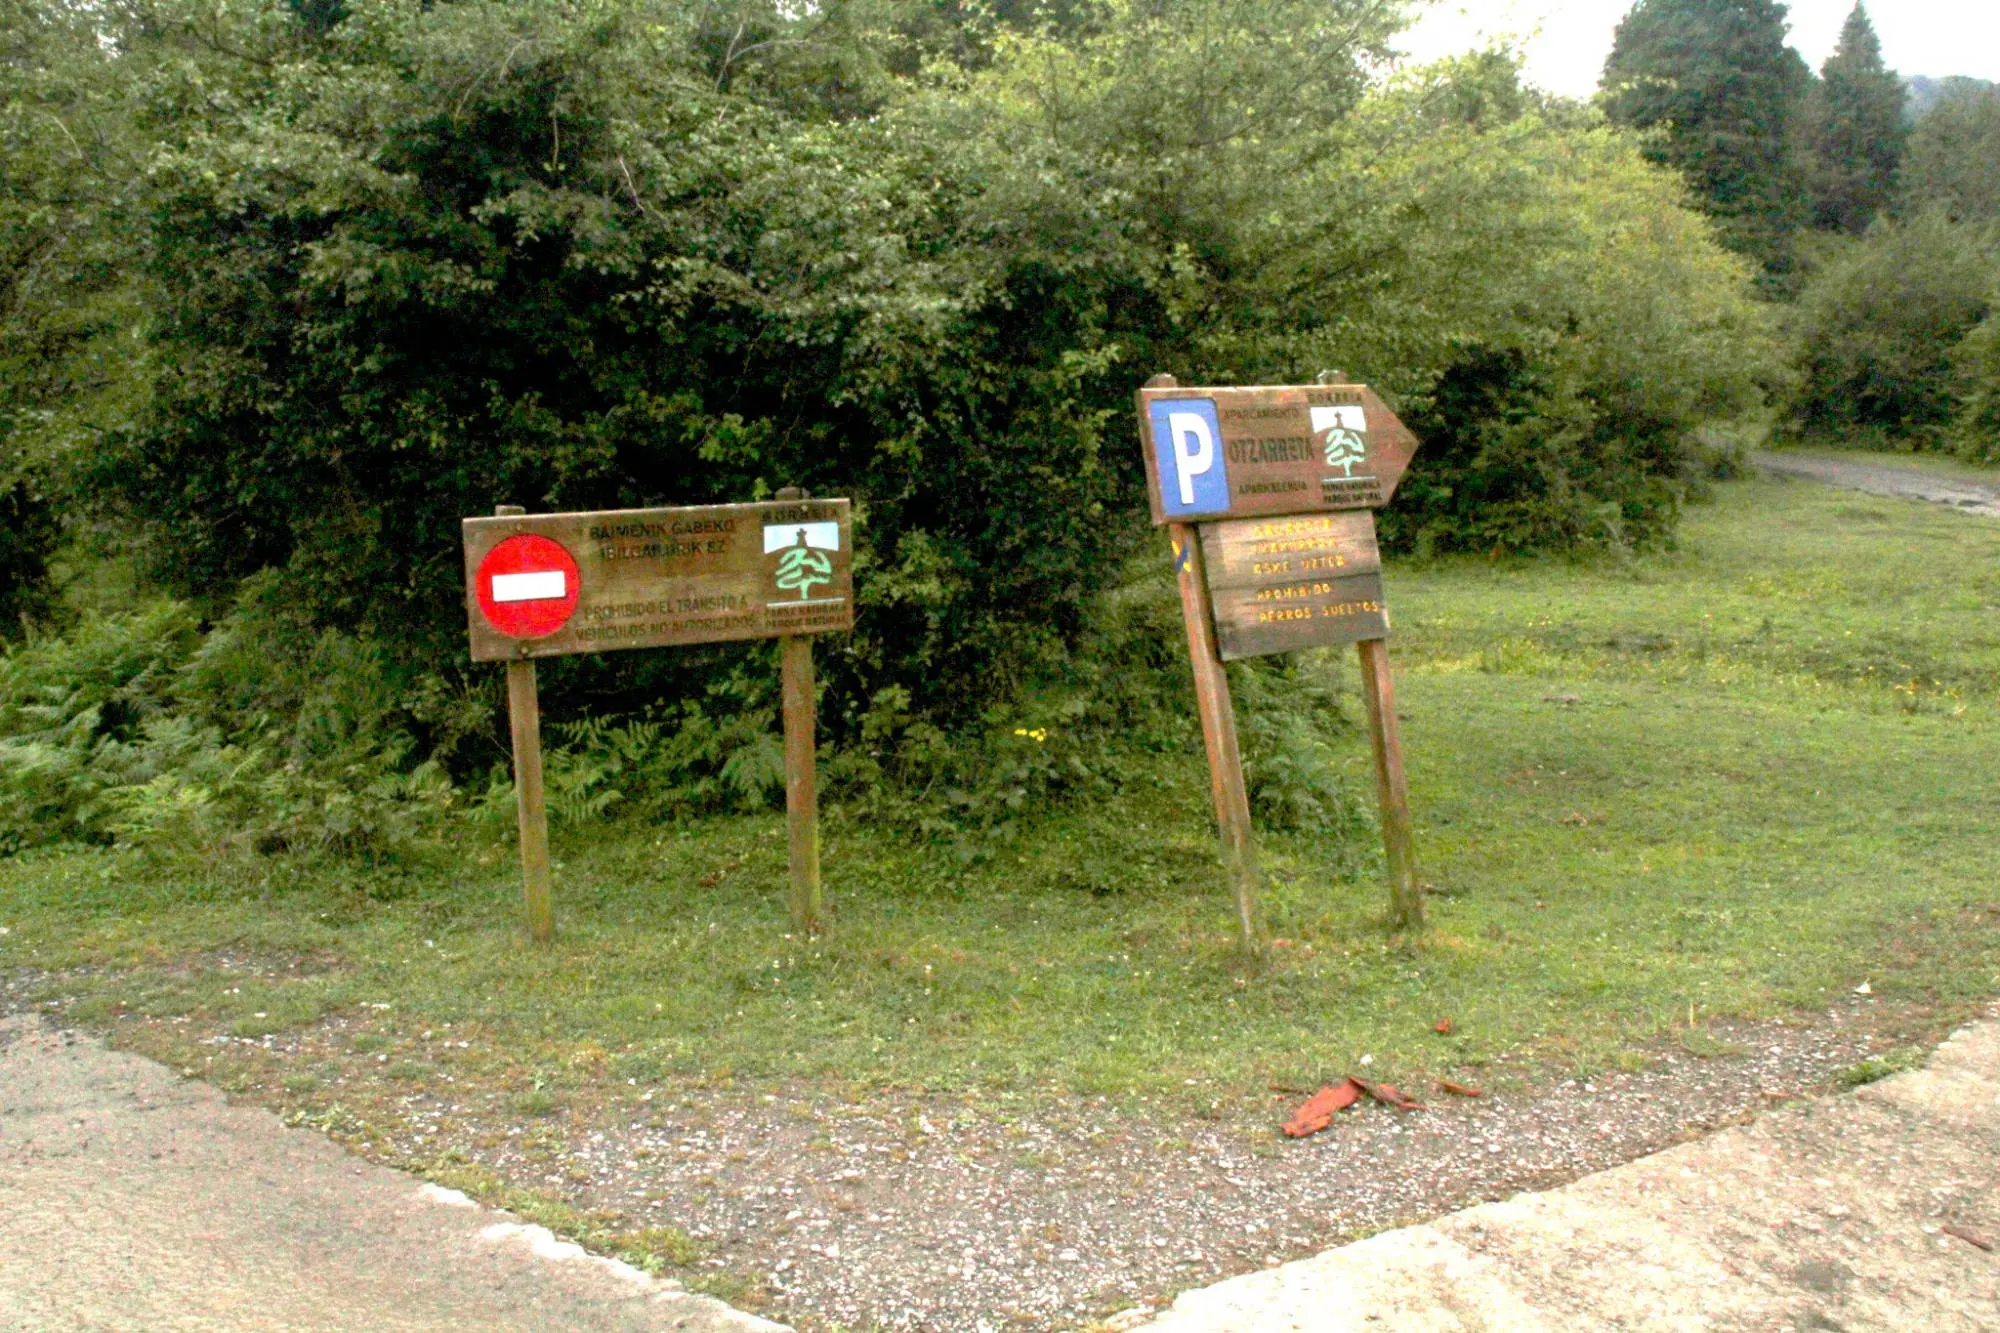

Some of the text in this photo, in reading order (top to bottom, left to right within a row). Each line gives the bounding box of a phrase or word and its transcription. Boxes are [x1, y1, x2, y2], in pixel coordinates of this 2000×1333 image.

[1169, 413, 1213, 505] P
[1228, 436, 1315, 464] OTZARRETA
[671, 519, 735, 535] GABEKO
[583, 602, 655, 621] PROHIBIDO
[659, 600, 674, 614] EL
[740, 595, 748, 606] A
[1259, 607, 1313, 624] PERROS
[650, 621, 668, 634] NO
